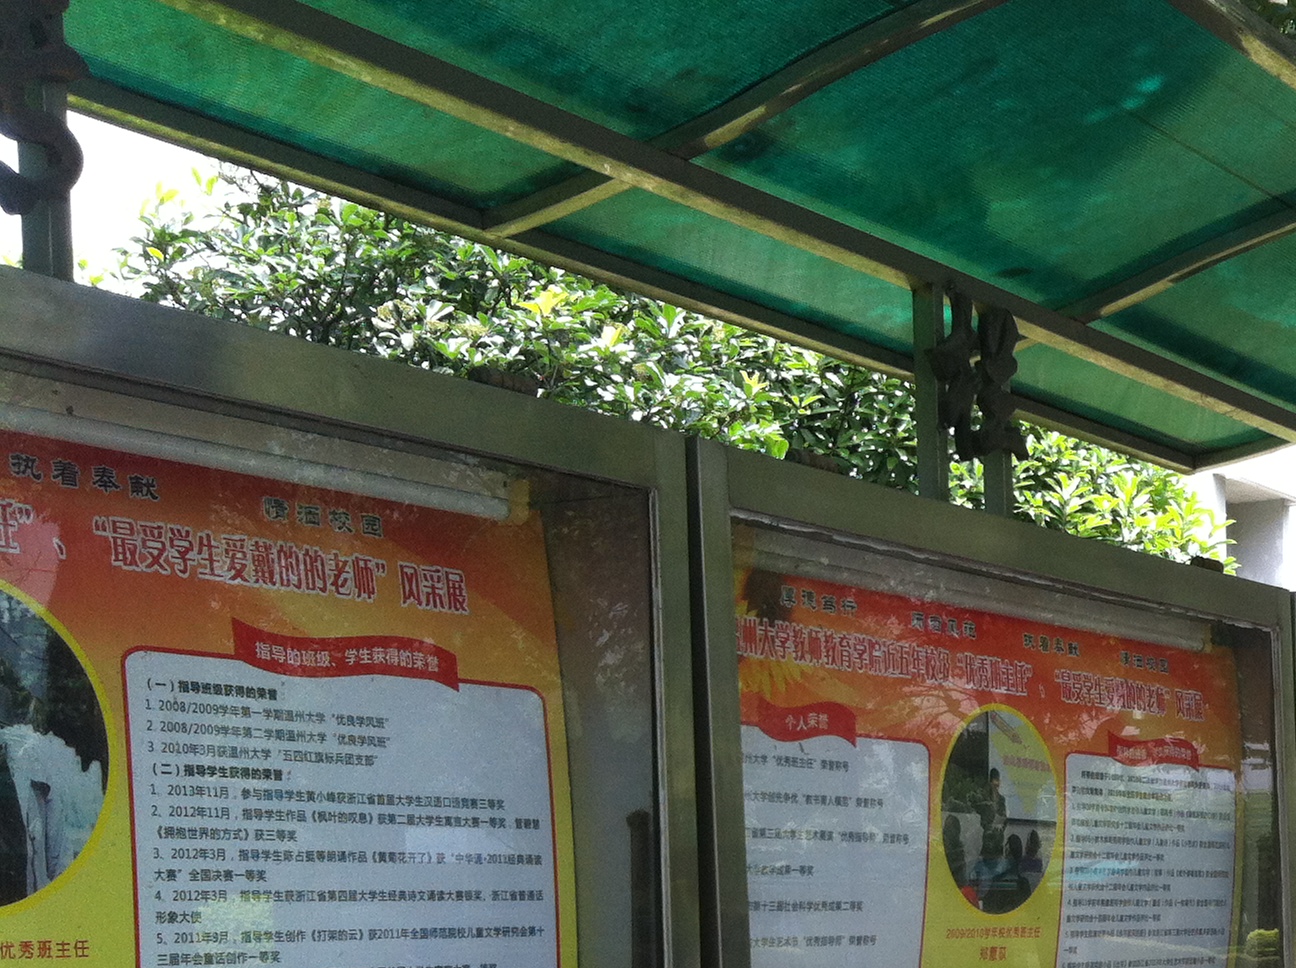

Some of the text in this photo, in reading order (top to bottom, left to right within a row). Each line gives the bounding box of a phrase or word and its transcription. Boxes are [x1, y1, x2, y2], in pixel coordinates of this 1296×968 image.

[9, 452, 160, 501] 执着奉献
[262, 496, 384, 538] 情洒校园
[254, 641, 440, 674] 指导的班级、学生获得的荣誉
[784, 712, 830, 731] 个人荣誉
[155, 910, 202, 925] 形象大使
[0, 939, 90, 960] 优秀班主任
